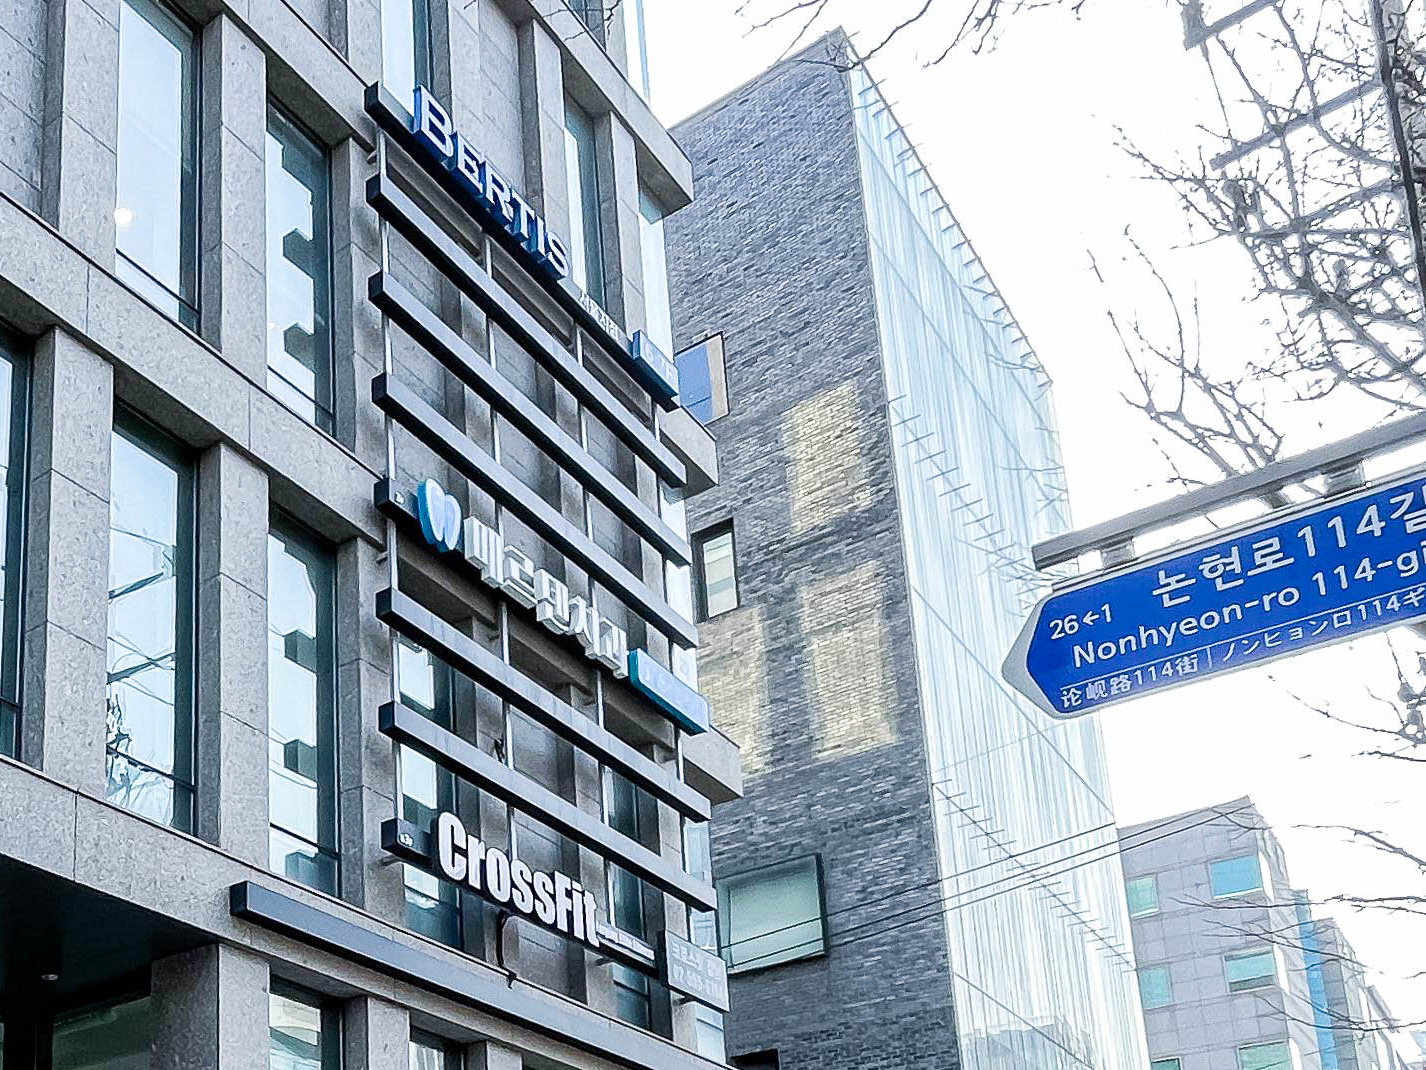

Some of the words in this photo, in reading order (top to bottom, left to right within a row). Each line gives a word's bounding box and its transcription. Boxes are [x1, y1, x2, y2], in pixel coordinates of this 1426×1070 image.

[413, 85, 571, 281] BERTIS
[1072, 586, 1301, 668] Nonhyeon-ro
[1311, 540, 1426, 597] 114-gi
[1222, 586, 1426, 663] ノンヒョンロ114ギ
[437, 811, 601, 949] CrossFit
